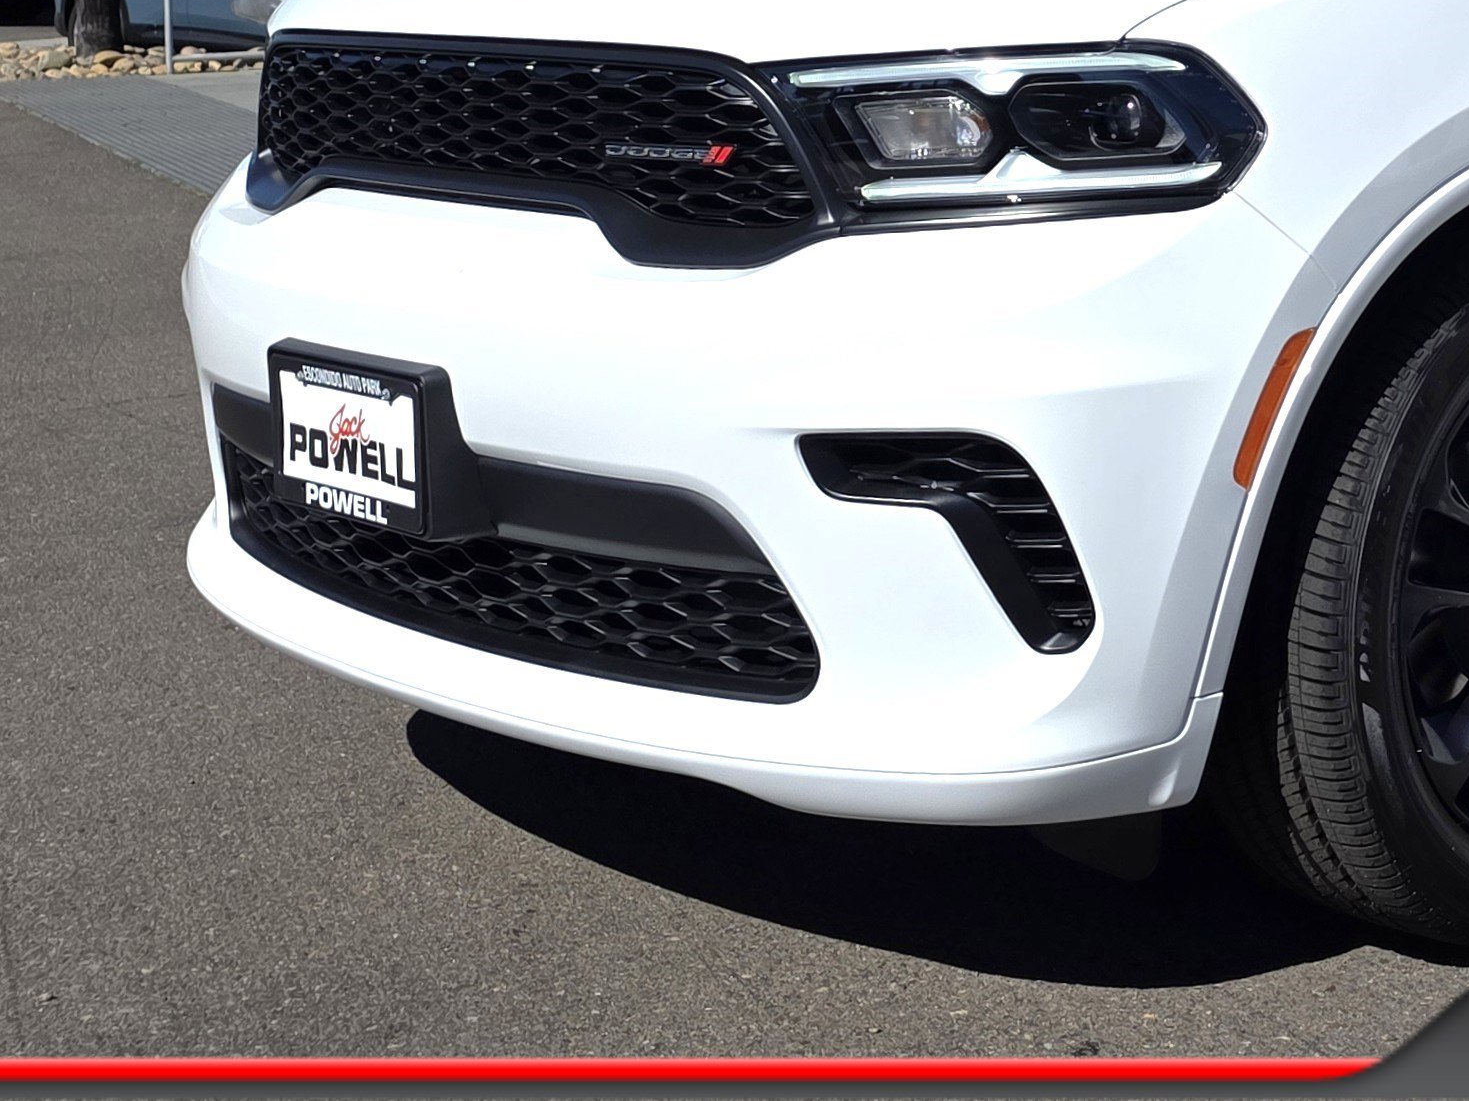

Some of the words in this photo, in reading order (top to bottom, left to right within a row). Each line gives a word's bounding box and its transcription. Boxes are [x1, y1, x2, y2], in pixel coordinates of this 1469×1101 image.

[605, 144, 716, 161] DODGE
[302, 365, 342, 388] ESCONDIDO
[342, 373, 362, 392] AUTO
[361, 377, 382, 396] PARK
[329, 403, 370, 455] Jack
[289, 422, 416, 490] POWELL
[305, 482, 388, 525] POWELL
